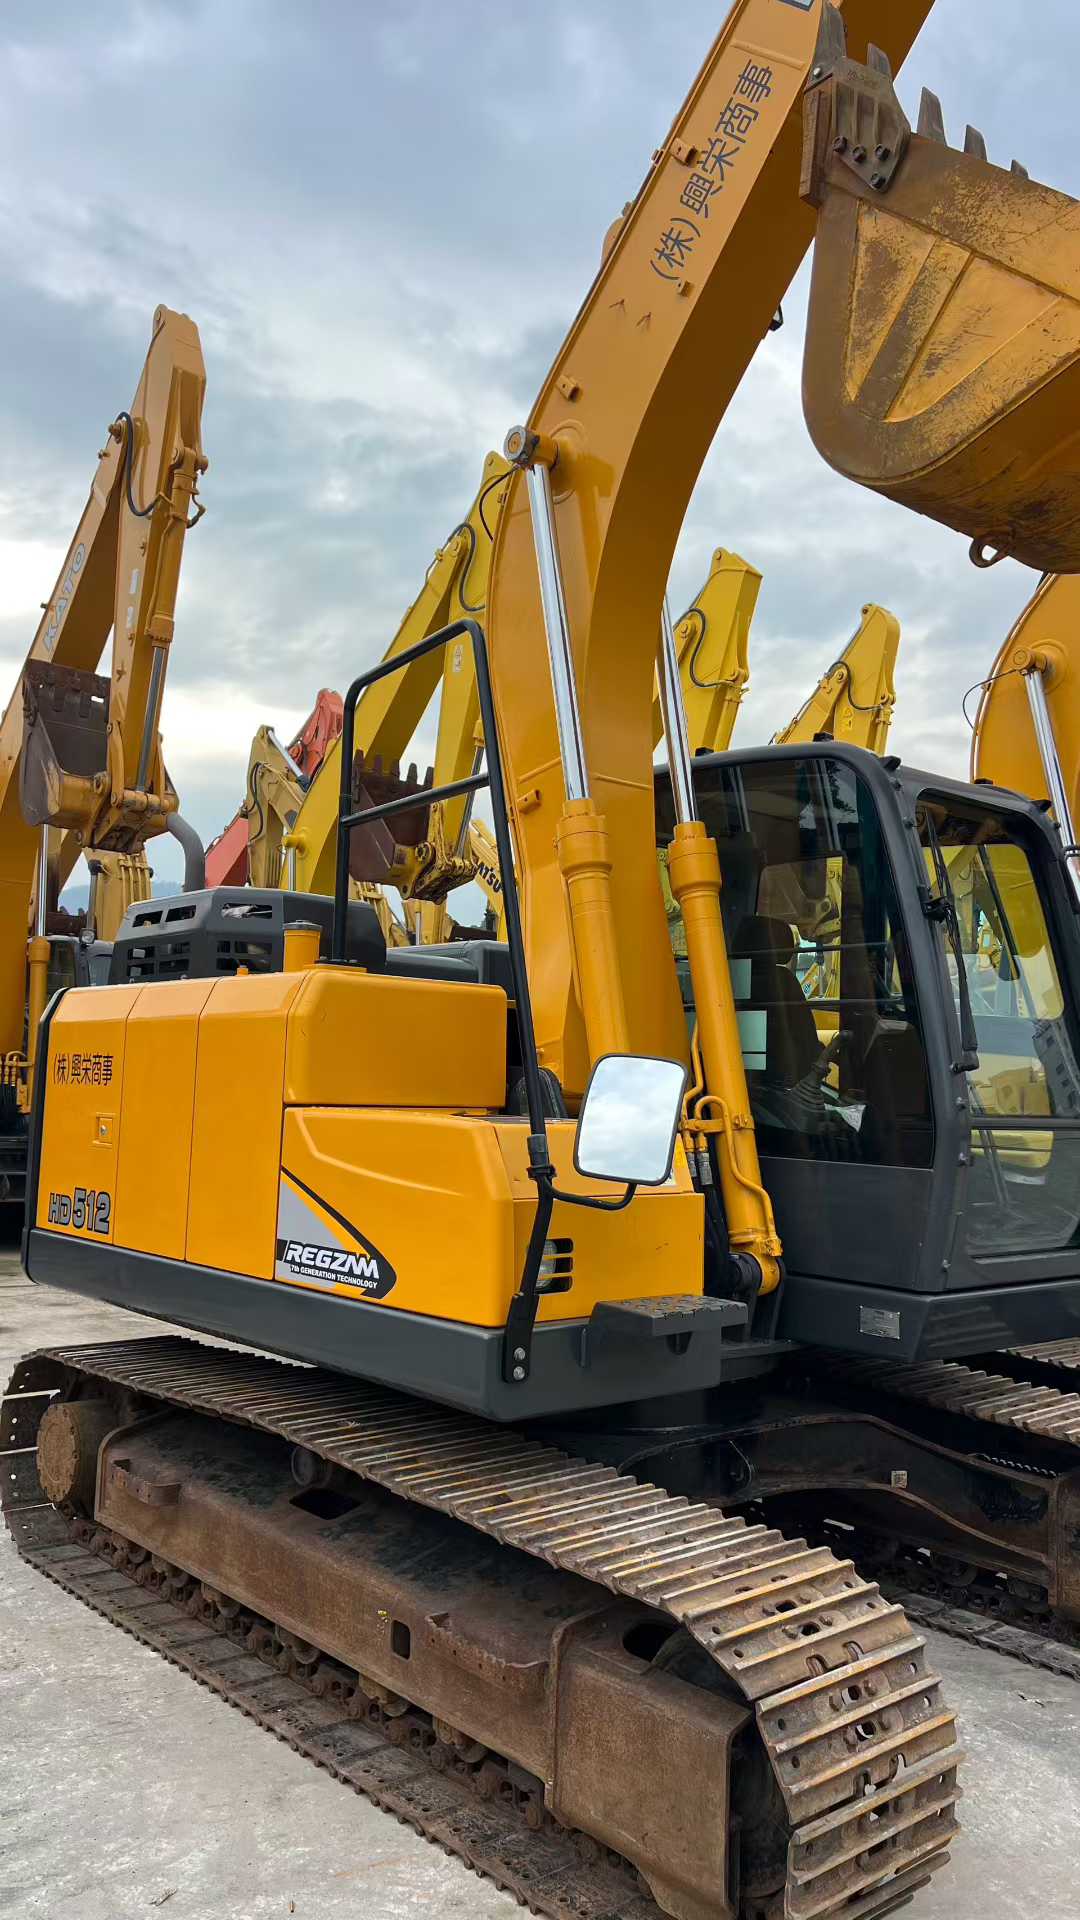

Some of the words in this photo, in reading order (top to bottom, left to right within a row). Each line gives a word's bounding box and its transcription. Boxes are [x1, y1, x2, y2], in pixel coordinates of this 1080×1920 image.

[43, 543, 86, 653] KATO
[48, 1187, 111, 1235] HD512
[300, 1266, 336, 1280] GENERATION
[337, 1274, 378, 1289] TECHNOLOGY
